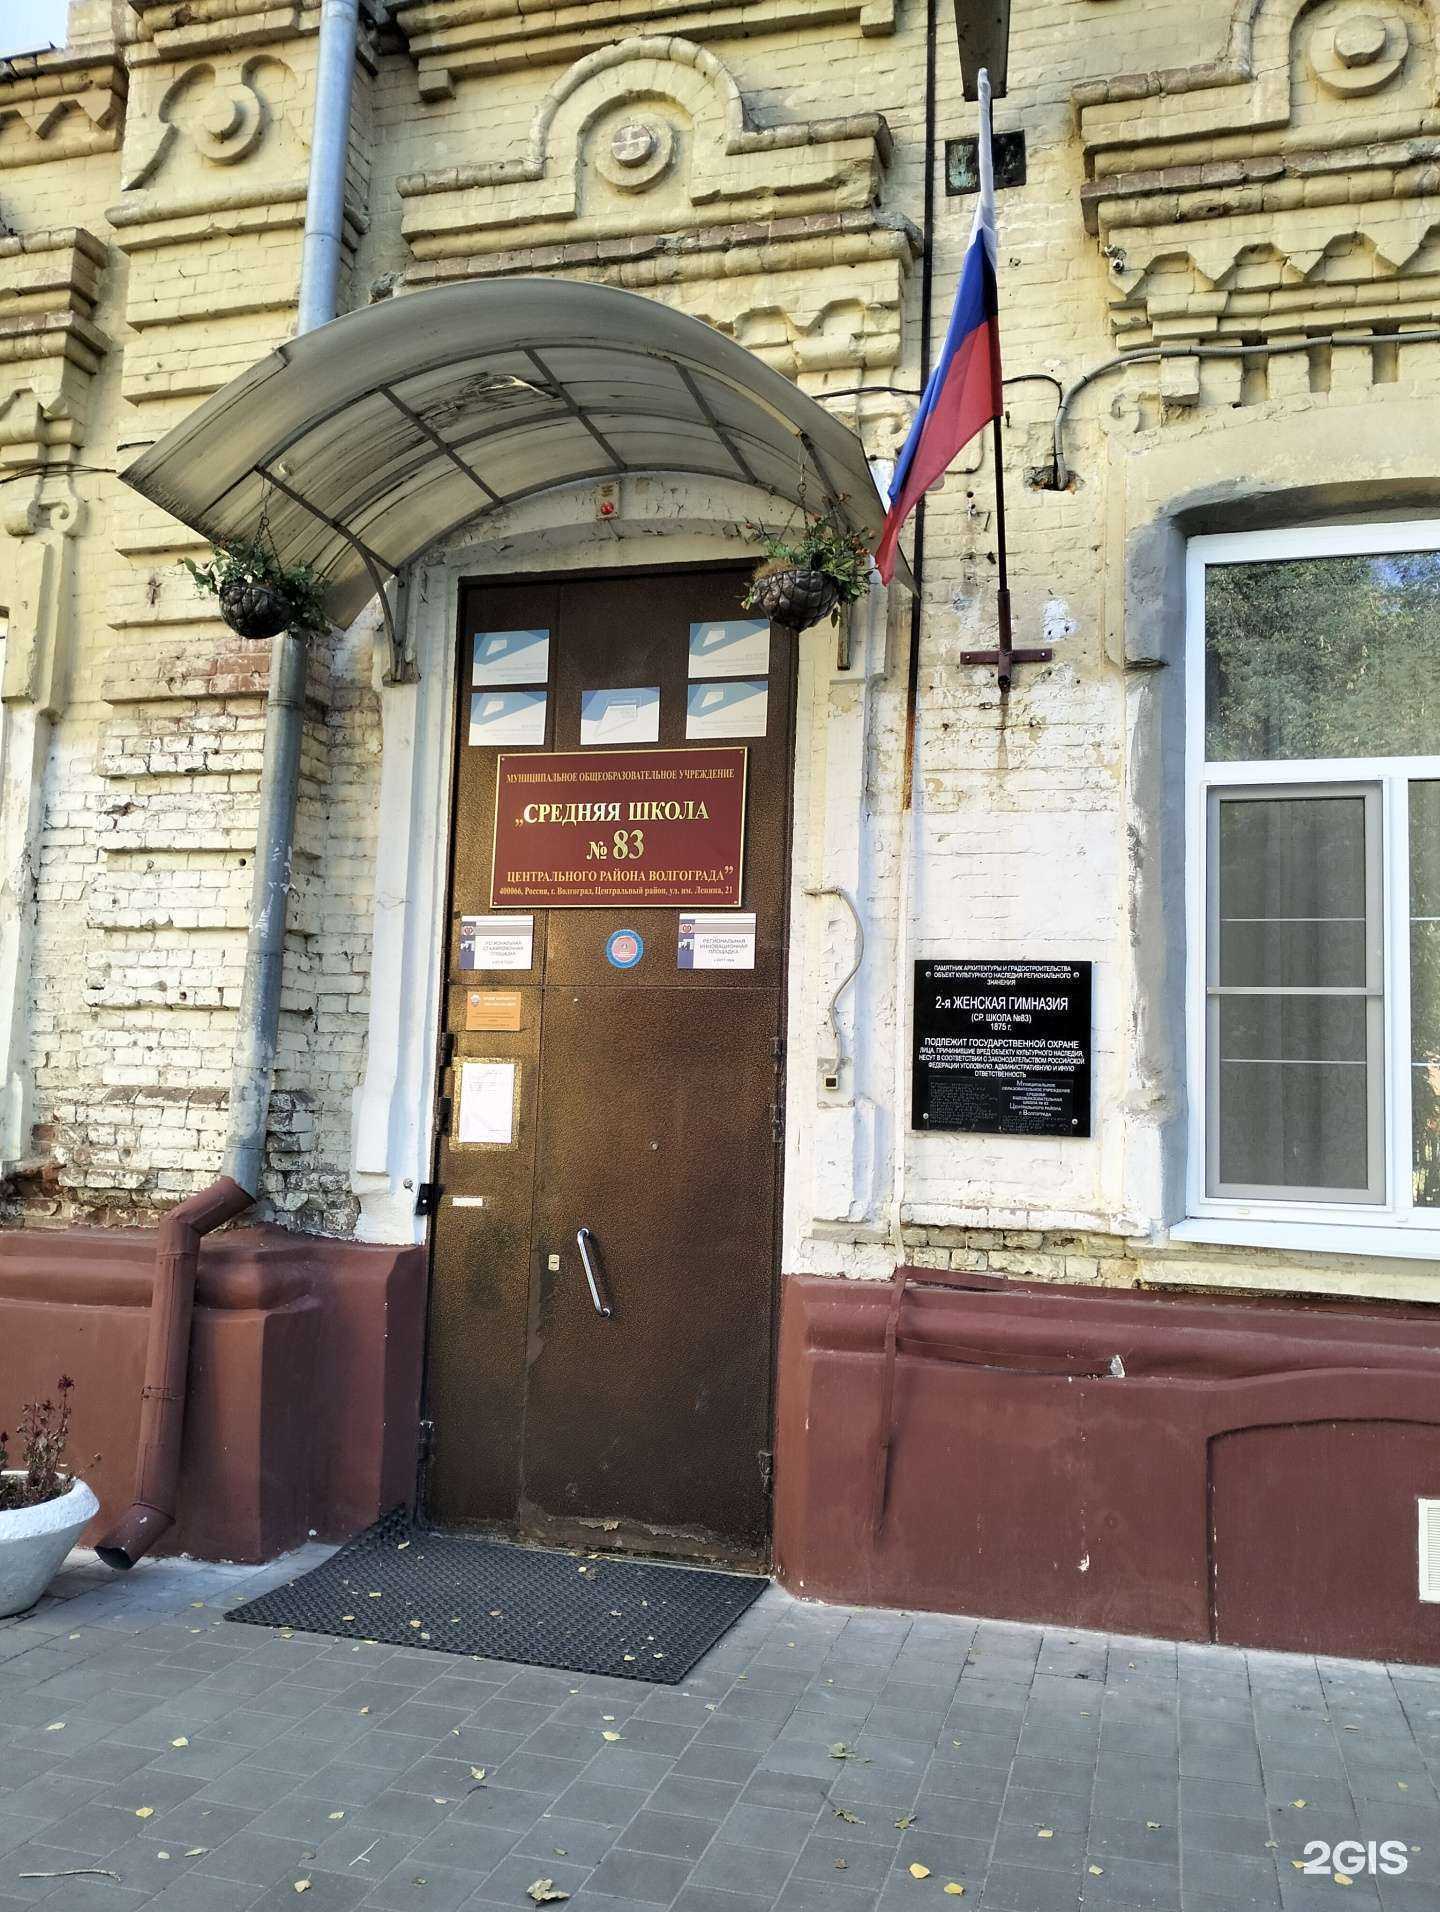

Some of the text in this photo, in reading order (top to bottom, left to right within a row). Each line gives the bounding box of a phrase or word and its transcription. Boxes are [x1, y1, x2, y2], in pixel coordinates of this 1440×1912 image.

[506, 768, 735, 784] МУНИЦИПАЛЬНОЕ ОБЩЕОБРАЗОВАТЕЛЬНОЕ УЧРЕЖДЕНИЕ
[628, 801, 710, 821] ШКОЛА
[586, 829, 645, 860] № 83
[507, 870, 598, 883] ЦЕНТРАЛЬНОГО
[599, 868, 646, 882] РАЙОНА
[725, 886, 733, 894] 21
[935, 996, 1069, 1010] 2-я ЖЕНСКАЯ ГИМНАЗИЯ
[986, 1013, 1012, 1022] ШКОЛА
[990, 1022, 1007, 1031] 1875
[924, 1037, 1080, 1049] ПОДЛЕЖИТ ГОСУДАРСТВЕННОЙ ОХРАНЕ
[991, 1048, 1015, 1056] ОБЪЕКТУ
[1047, 1057, 1085, 1065] РОССИЙСКОЙ
[974, 1070, 1027, 1078] ОТВЕТСТВЕННОСТЬ
